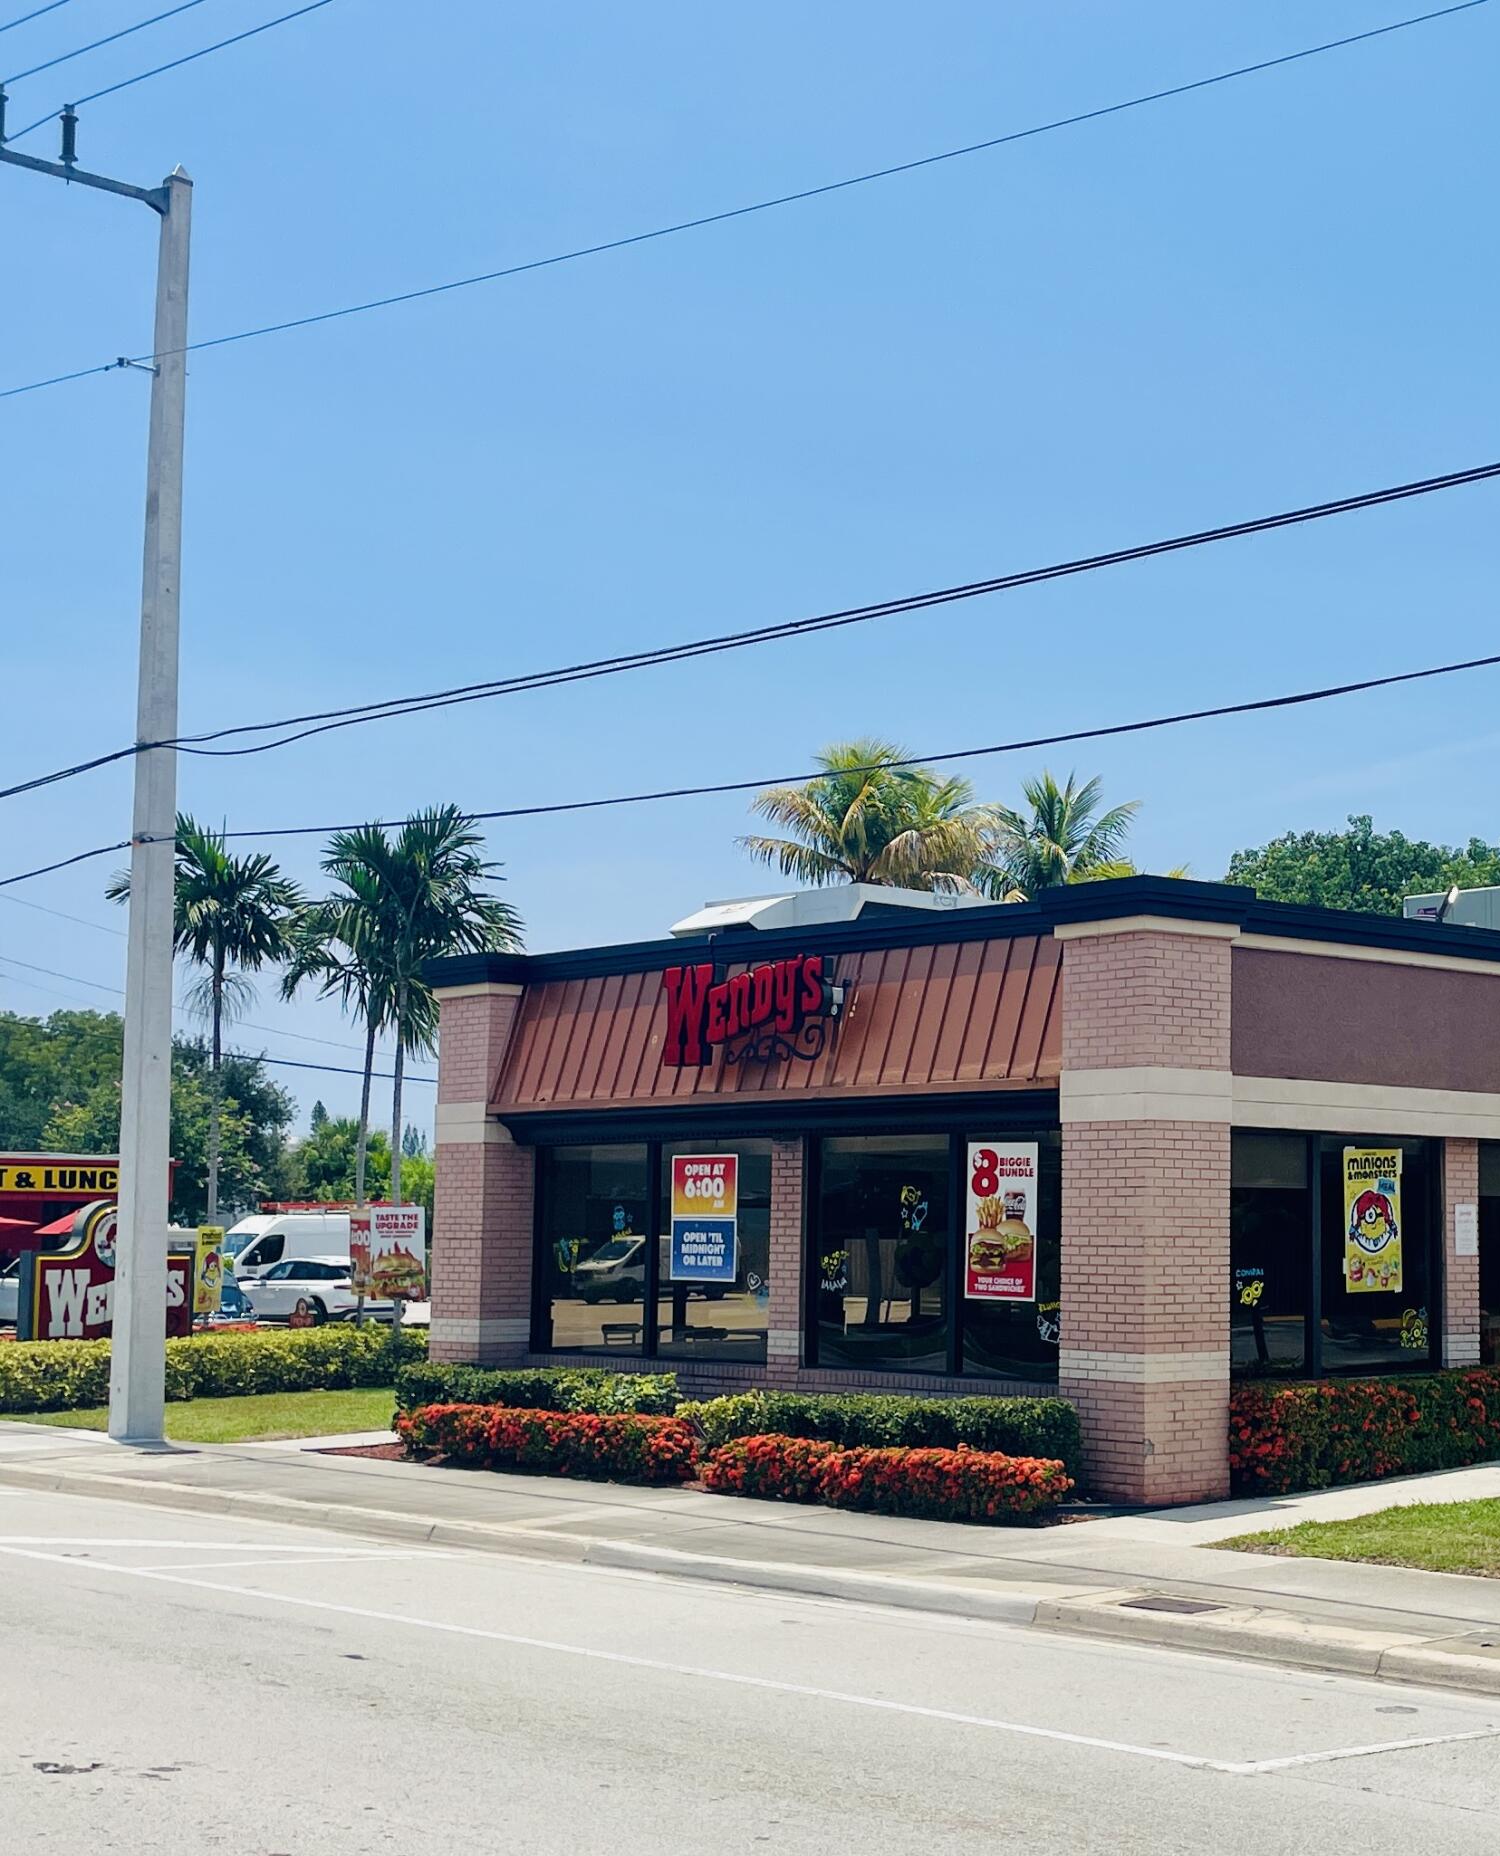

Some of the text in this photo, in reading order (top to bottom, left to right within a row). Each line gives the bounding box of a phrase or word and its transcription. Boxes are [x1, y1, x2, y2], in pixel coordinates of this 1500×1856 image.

[1000, 1157, 1031, 1168] BIGGIE
[684, 1163, 726, 1176] OPEN AT
[1000, 1168, 1034, 1178] BUNDLE
[15, 1172, 36, 1188] &
[684, 1177, 725, 1198] 6:00
[402, 1213, 419, 1221] THE
[376, 1222, 419, 1230] UPGRADE
[683, 1232, 707, 1243] OPEN
[681, 1243, 726, 1255] MIDNIGHT
[682, 1255, 723, 1267] OR LATER
